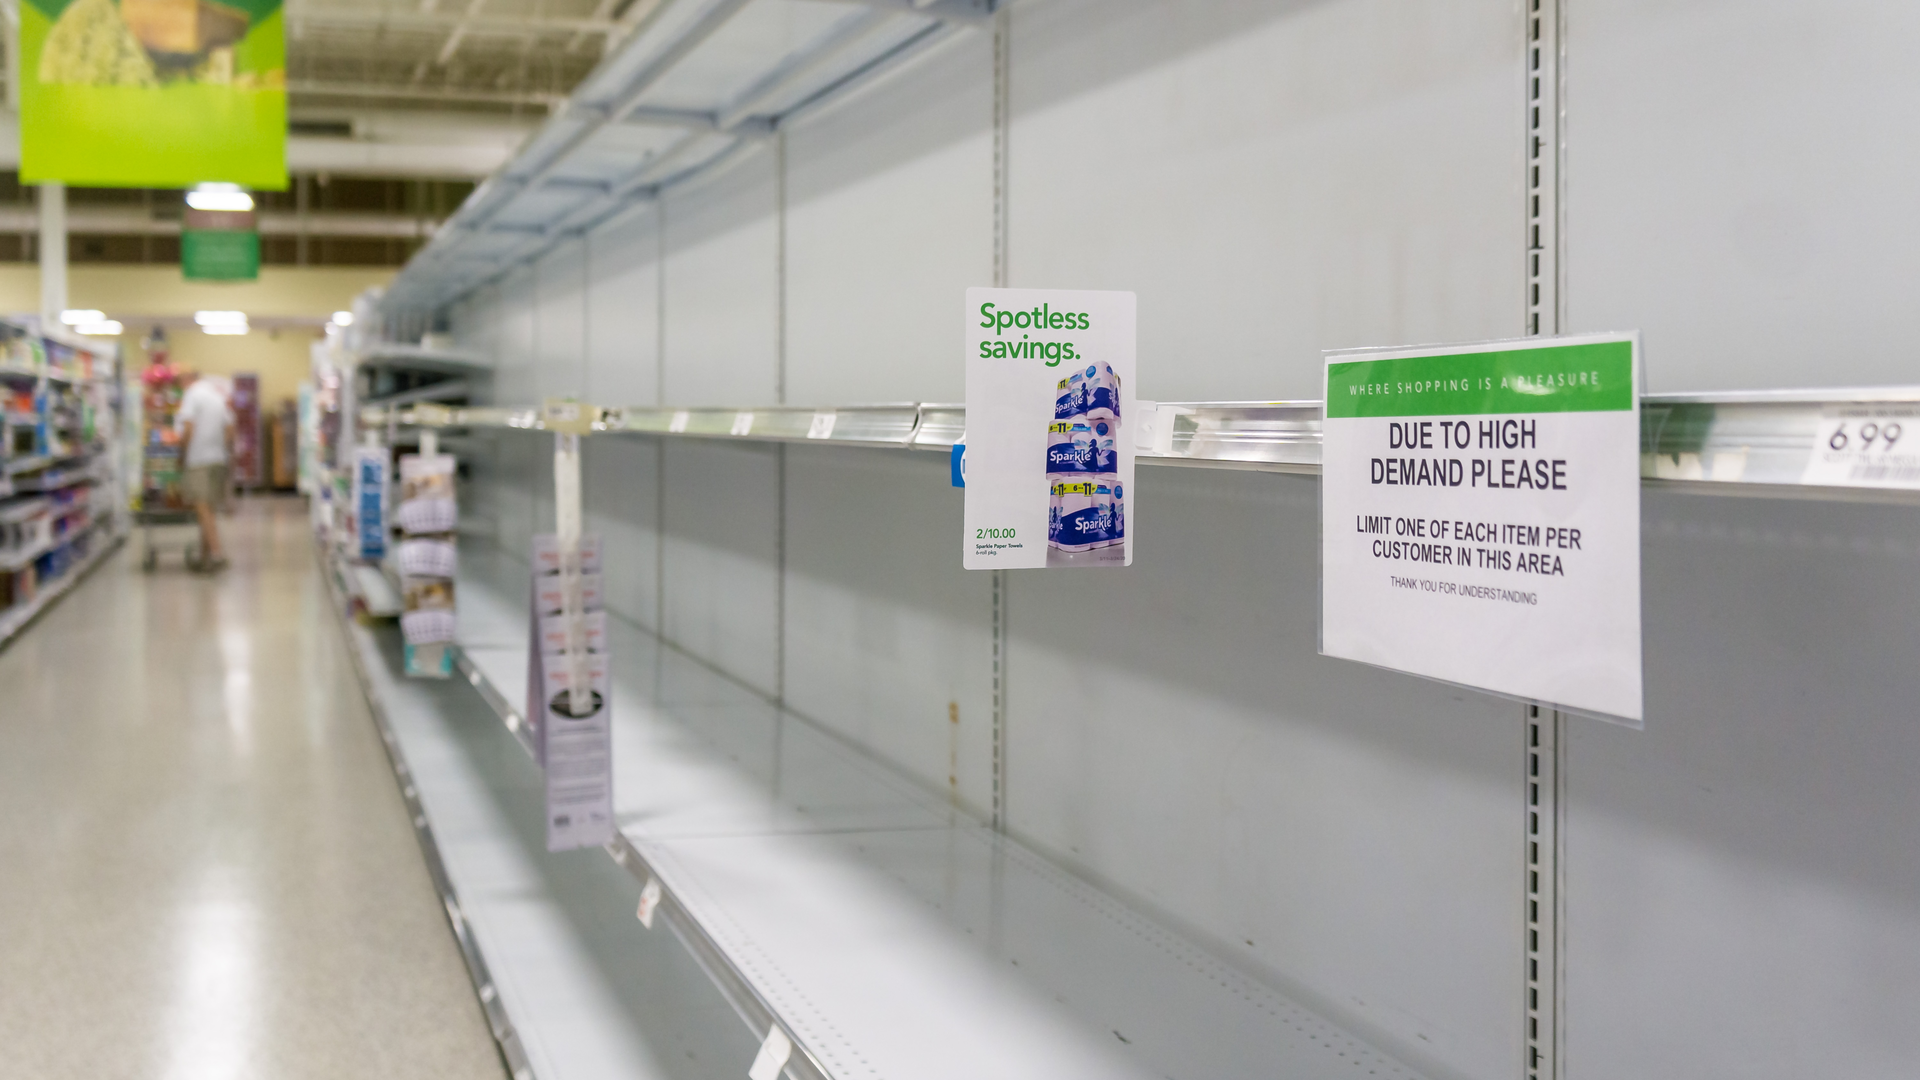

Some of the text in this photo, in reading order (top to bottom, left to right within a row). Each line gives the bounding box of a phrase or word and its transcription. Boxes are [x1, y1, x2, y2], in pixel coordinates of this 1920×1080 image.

[980, 302, 1090, 335] Spotless
[979, 334, 1081, 367] savings.
[1349, 371, 1599, 395] WHERE SHOPPING IS A PLEASURE
[1057, 422, 1067, 433] 11
[1390, 419, 1536, 449] DUE TO HIGH
[1829, 422, 1902, 451] 699
[1050, 449, 1091, 464] Sparkle
[1083, 482, 1092, 495] 11
[1371, 458, 1567, 490] DEMAND PLEASE
[976, 528, 1016, 539] 2/10.00
[1075, 515, 1112, 534] Sparkle
[1356, 515, 1582, 550] LIMIT ONE OF EACH ITEM PER
[1372, 539, 1564, 577] CUSTOMER IN THIS AREA
[1390, 575, 1537, 606] THANK YOU FOR UNDERSTANDING
